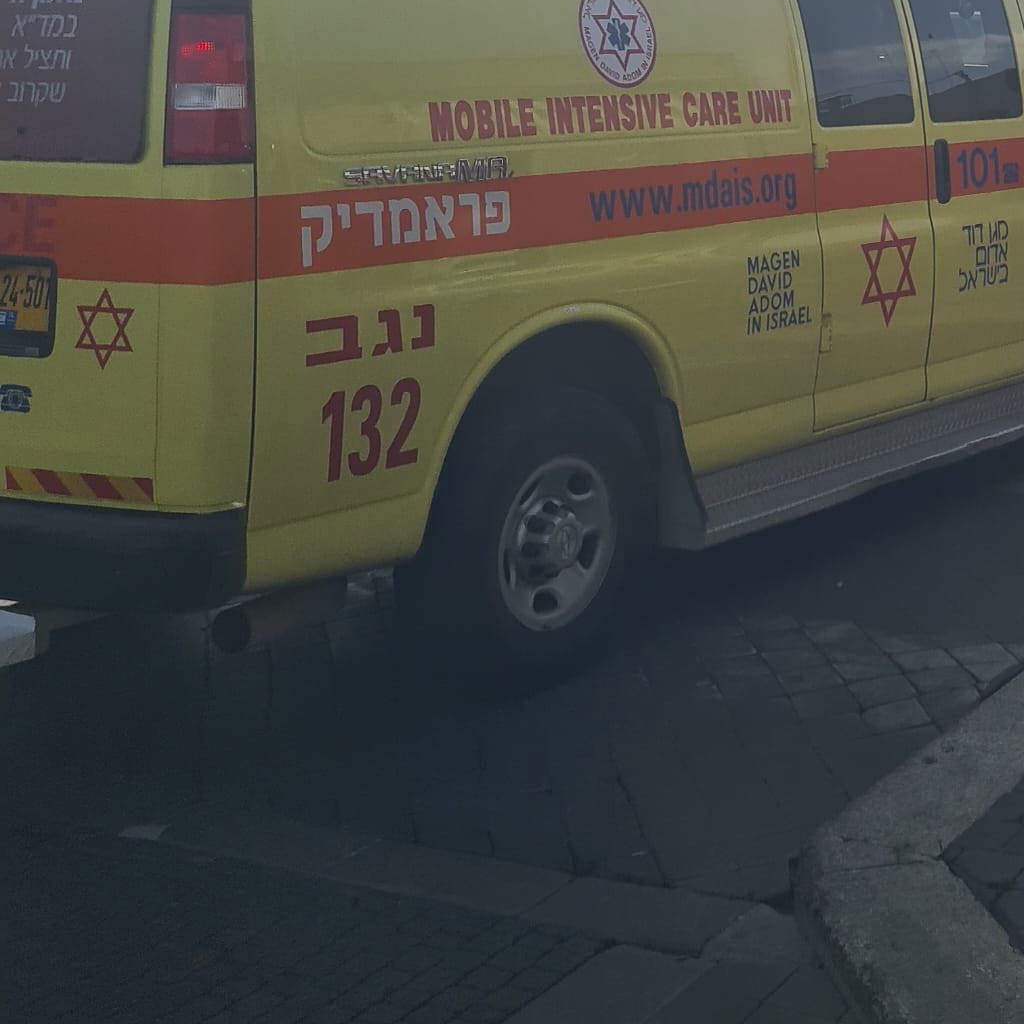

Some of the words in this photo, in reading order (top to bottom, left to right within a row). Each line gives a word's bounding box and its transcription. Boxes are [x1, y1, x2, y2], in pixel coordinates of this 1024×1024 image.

[622, 68, 642, 82] ADOM
[7, 81, 67, 108] שקרוב
[428, 97, 537, 143] MOBILE
[545, 92, 674, 136] INTENSIVE
[682, 90, 742, 127] CARE
[746, 88, 792, 125] UNIT
[956, 146, 1000, 190] 101
[588, 167, 798, 224] www.mdais.org
[300, 190, 511, 268] פראמדיק
[962, 223, 983, 246] דוד
[989, 220, 1009, 244] מגן
[747, 249, 800, 275] MAGEN
[976, 242, 1008, 268] אדום
[748, 271, 793, 295] DAVID
[959, 264, 1009, 292] בישראל
[748, 289, 794, 316] ADOM
[747, 316, 762, 336] IN
[766, 306, 812, 331] ISRAEL
[305, 303, 435, 367] נגב
[321, 377, 421, 482] 132
